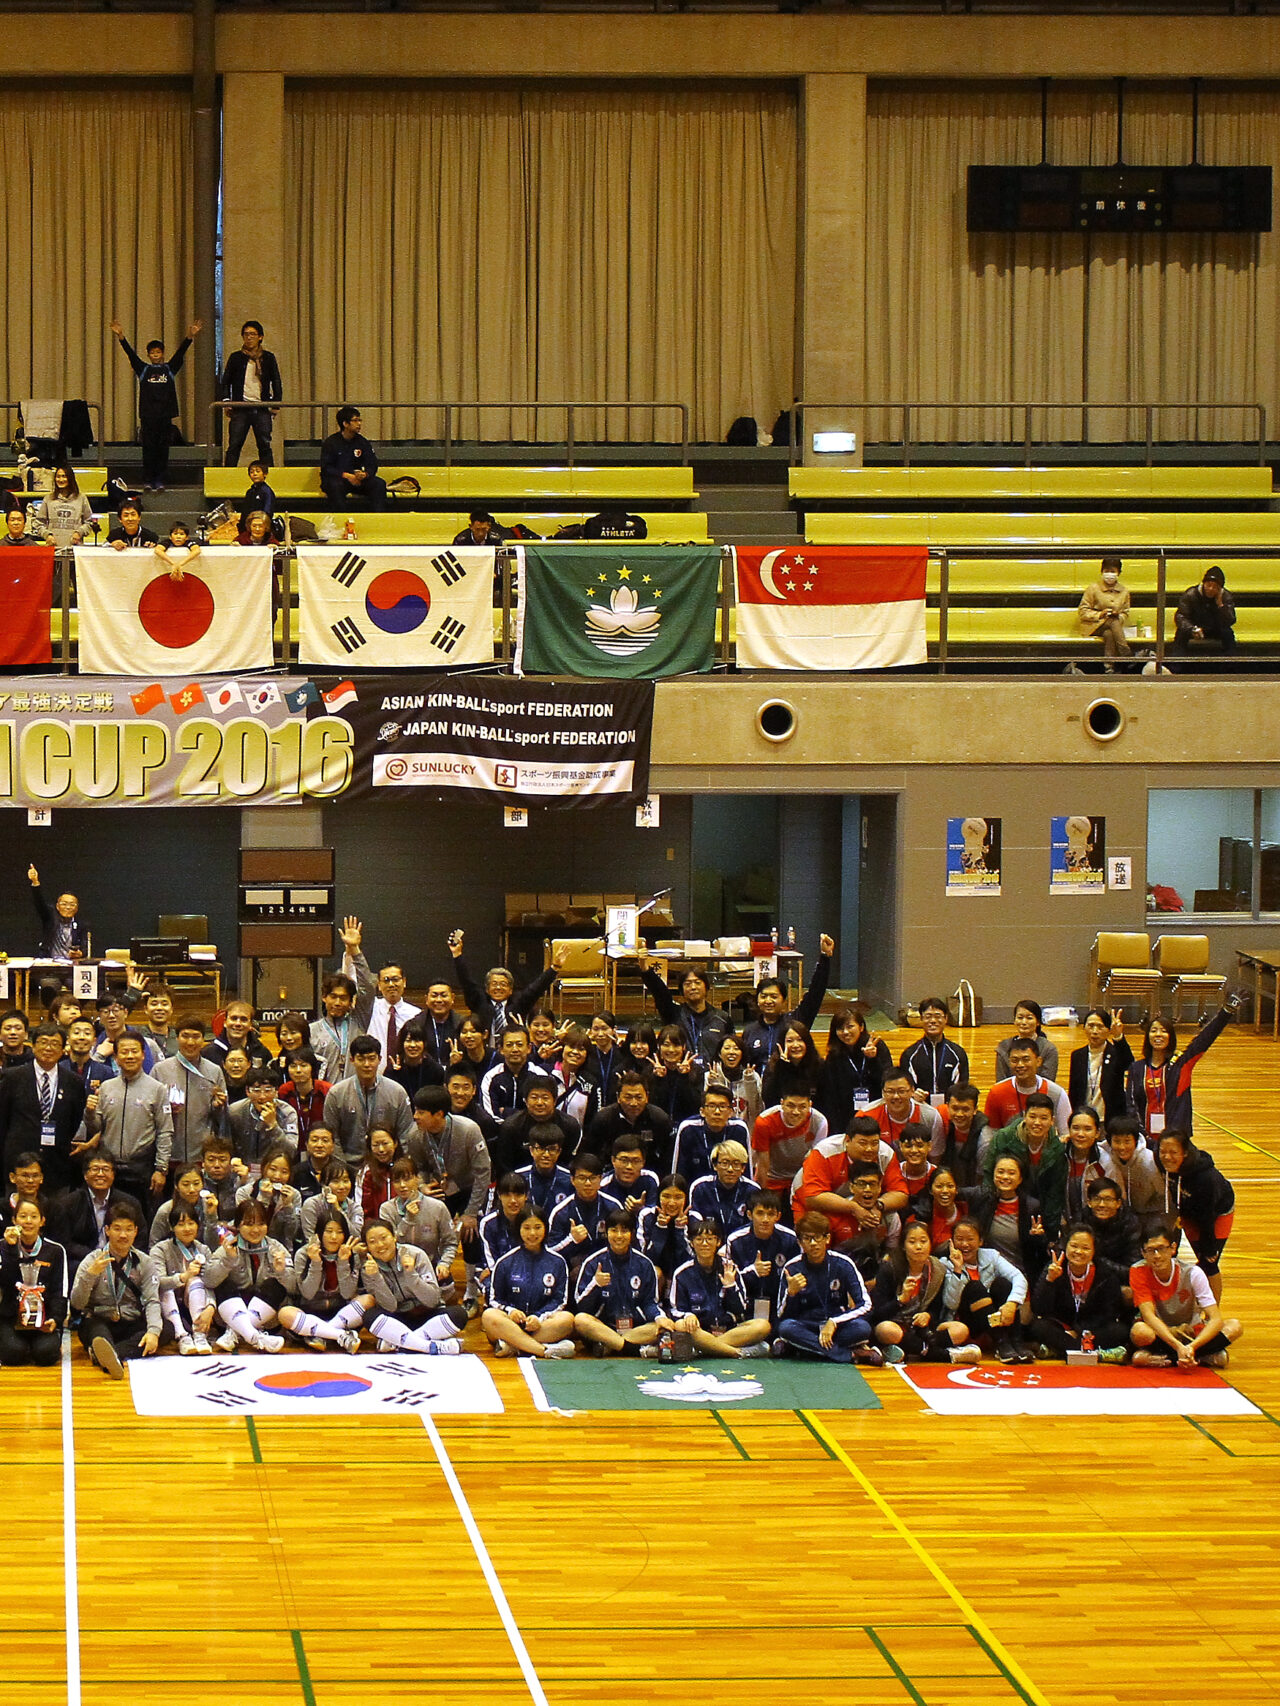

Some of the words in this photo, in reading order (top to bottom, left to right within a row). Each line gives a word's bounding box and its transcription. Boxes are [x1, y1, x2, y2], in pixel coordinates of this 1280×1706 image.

[380, 695, 425, 710] ASIAN
[527, 702, 614, 717] FEDERATION
[403, 721, 448, 736] JAPAN
[552, 729, 636, 745] FEDERATION
[20, 717, 171, 802] CUP
[174, 714, 355, 798] 2016
[412, 763, 476, 775] SUNLUCKY
[1114, 861, 1127, 885] 放送
[80, 971, 93, 994] 司会
